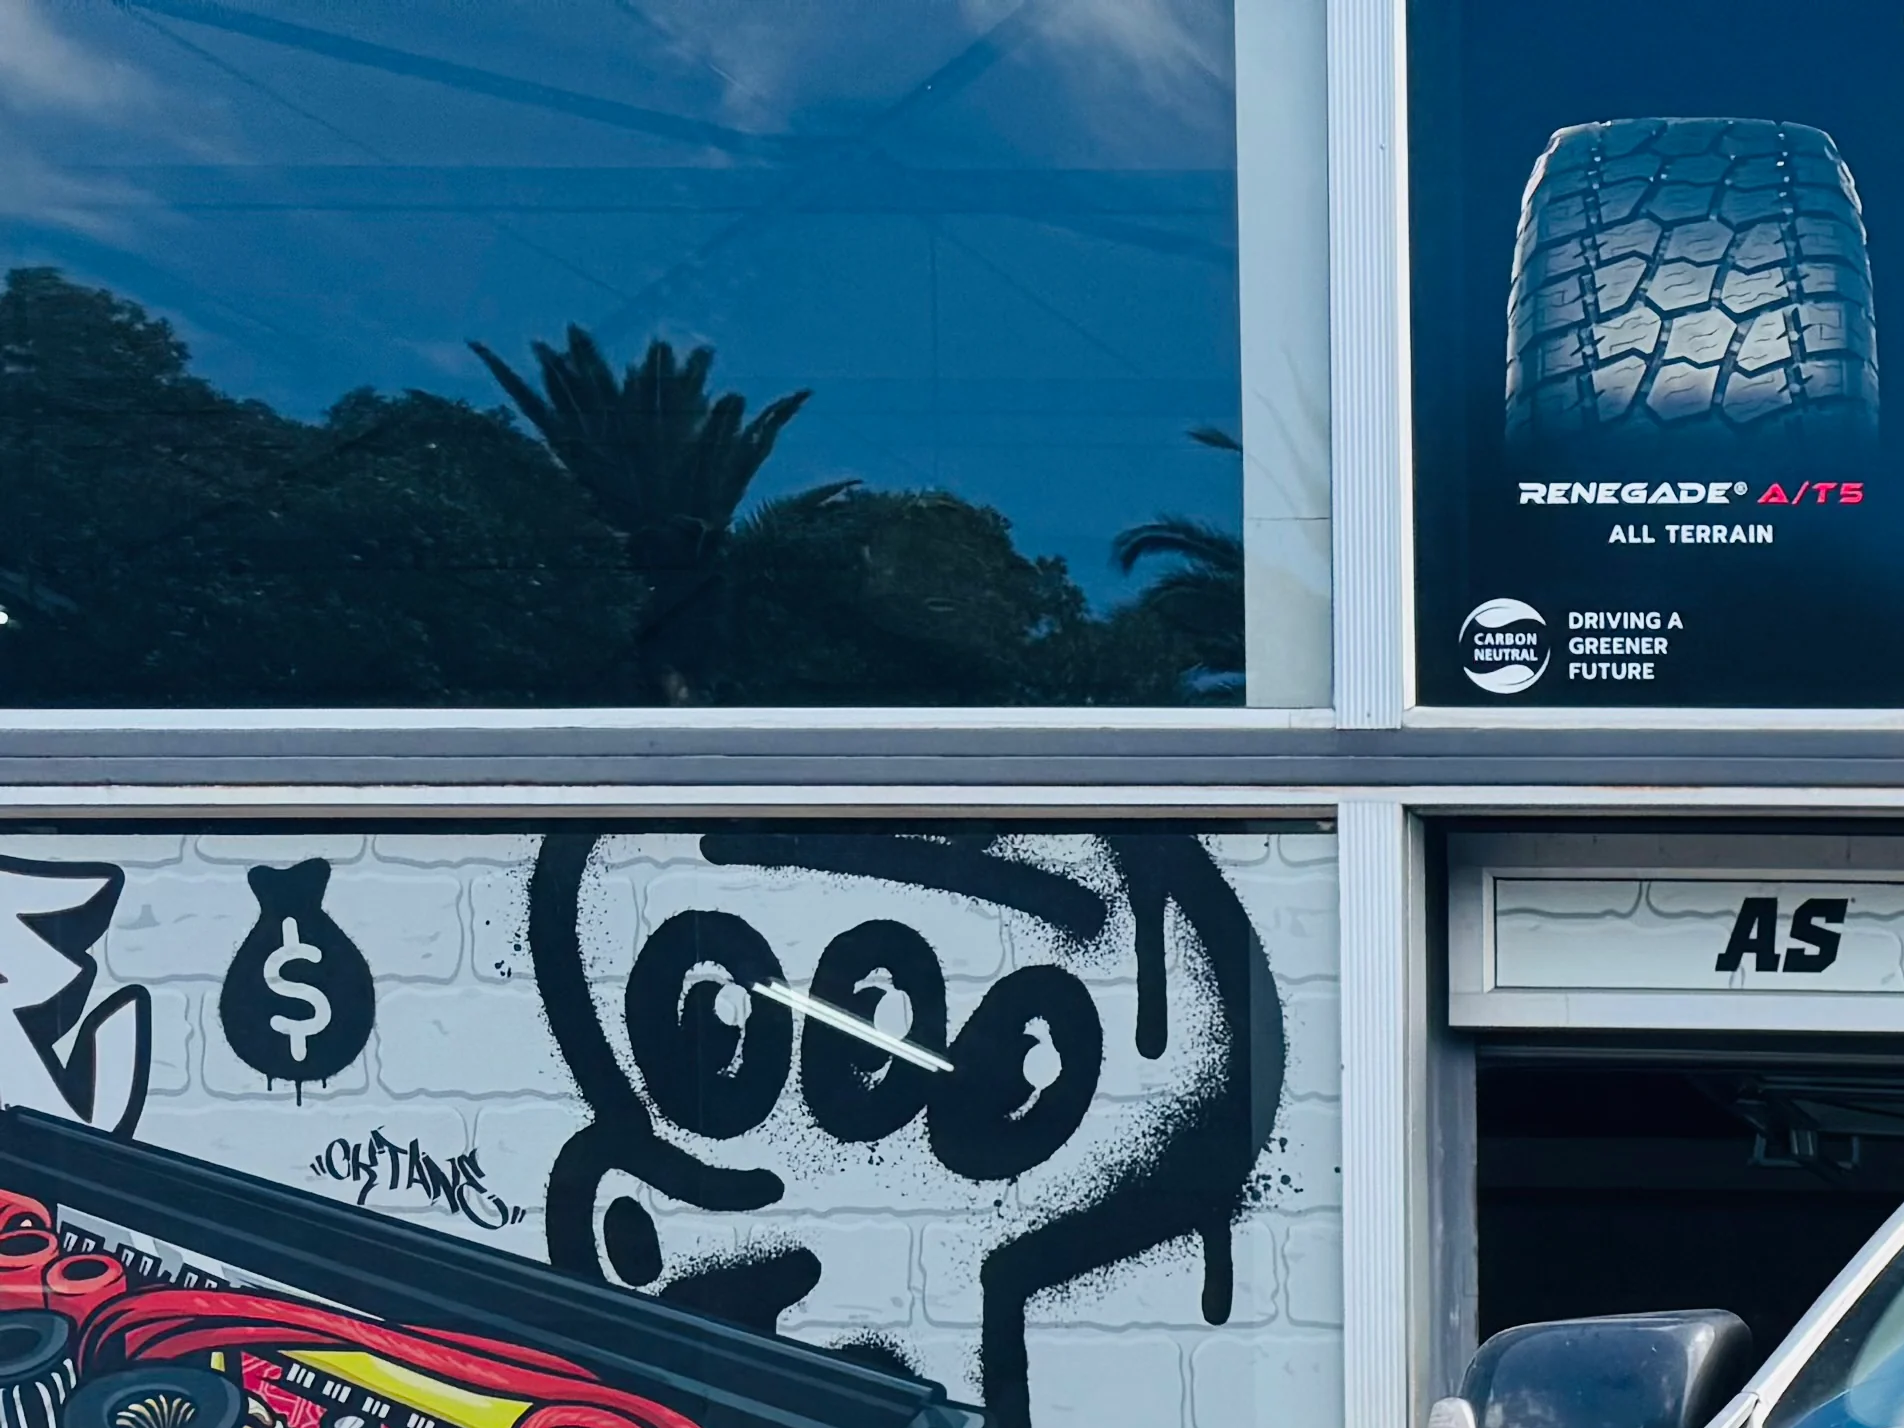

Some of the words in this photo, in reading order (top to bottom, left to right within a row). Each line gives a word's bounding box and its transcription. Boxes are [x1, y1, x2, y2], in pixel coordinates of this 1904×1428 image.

[1608, 524, 1656, 544] ALL
[1664, 524, 1774, 544] TERRAIN
[1568, 611, 1662, 630] DRIVING
[1667, 611, 1684, 630] A
[1473, 632, 1538, 646] CARBON
[1568, 636, 1669, 655] GREENER
[1473, 647, 1539, 662] NEUTRAL
[1568, 662, 1655, 680] FUTURE
[1715, 896, 1849, 973] AS
